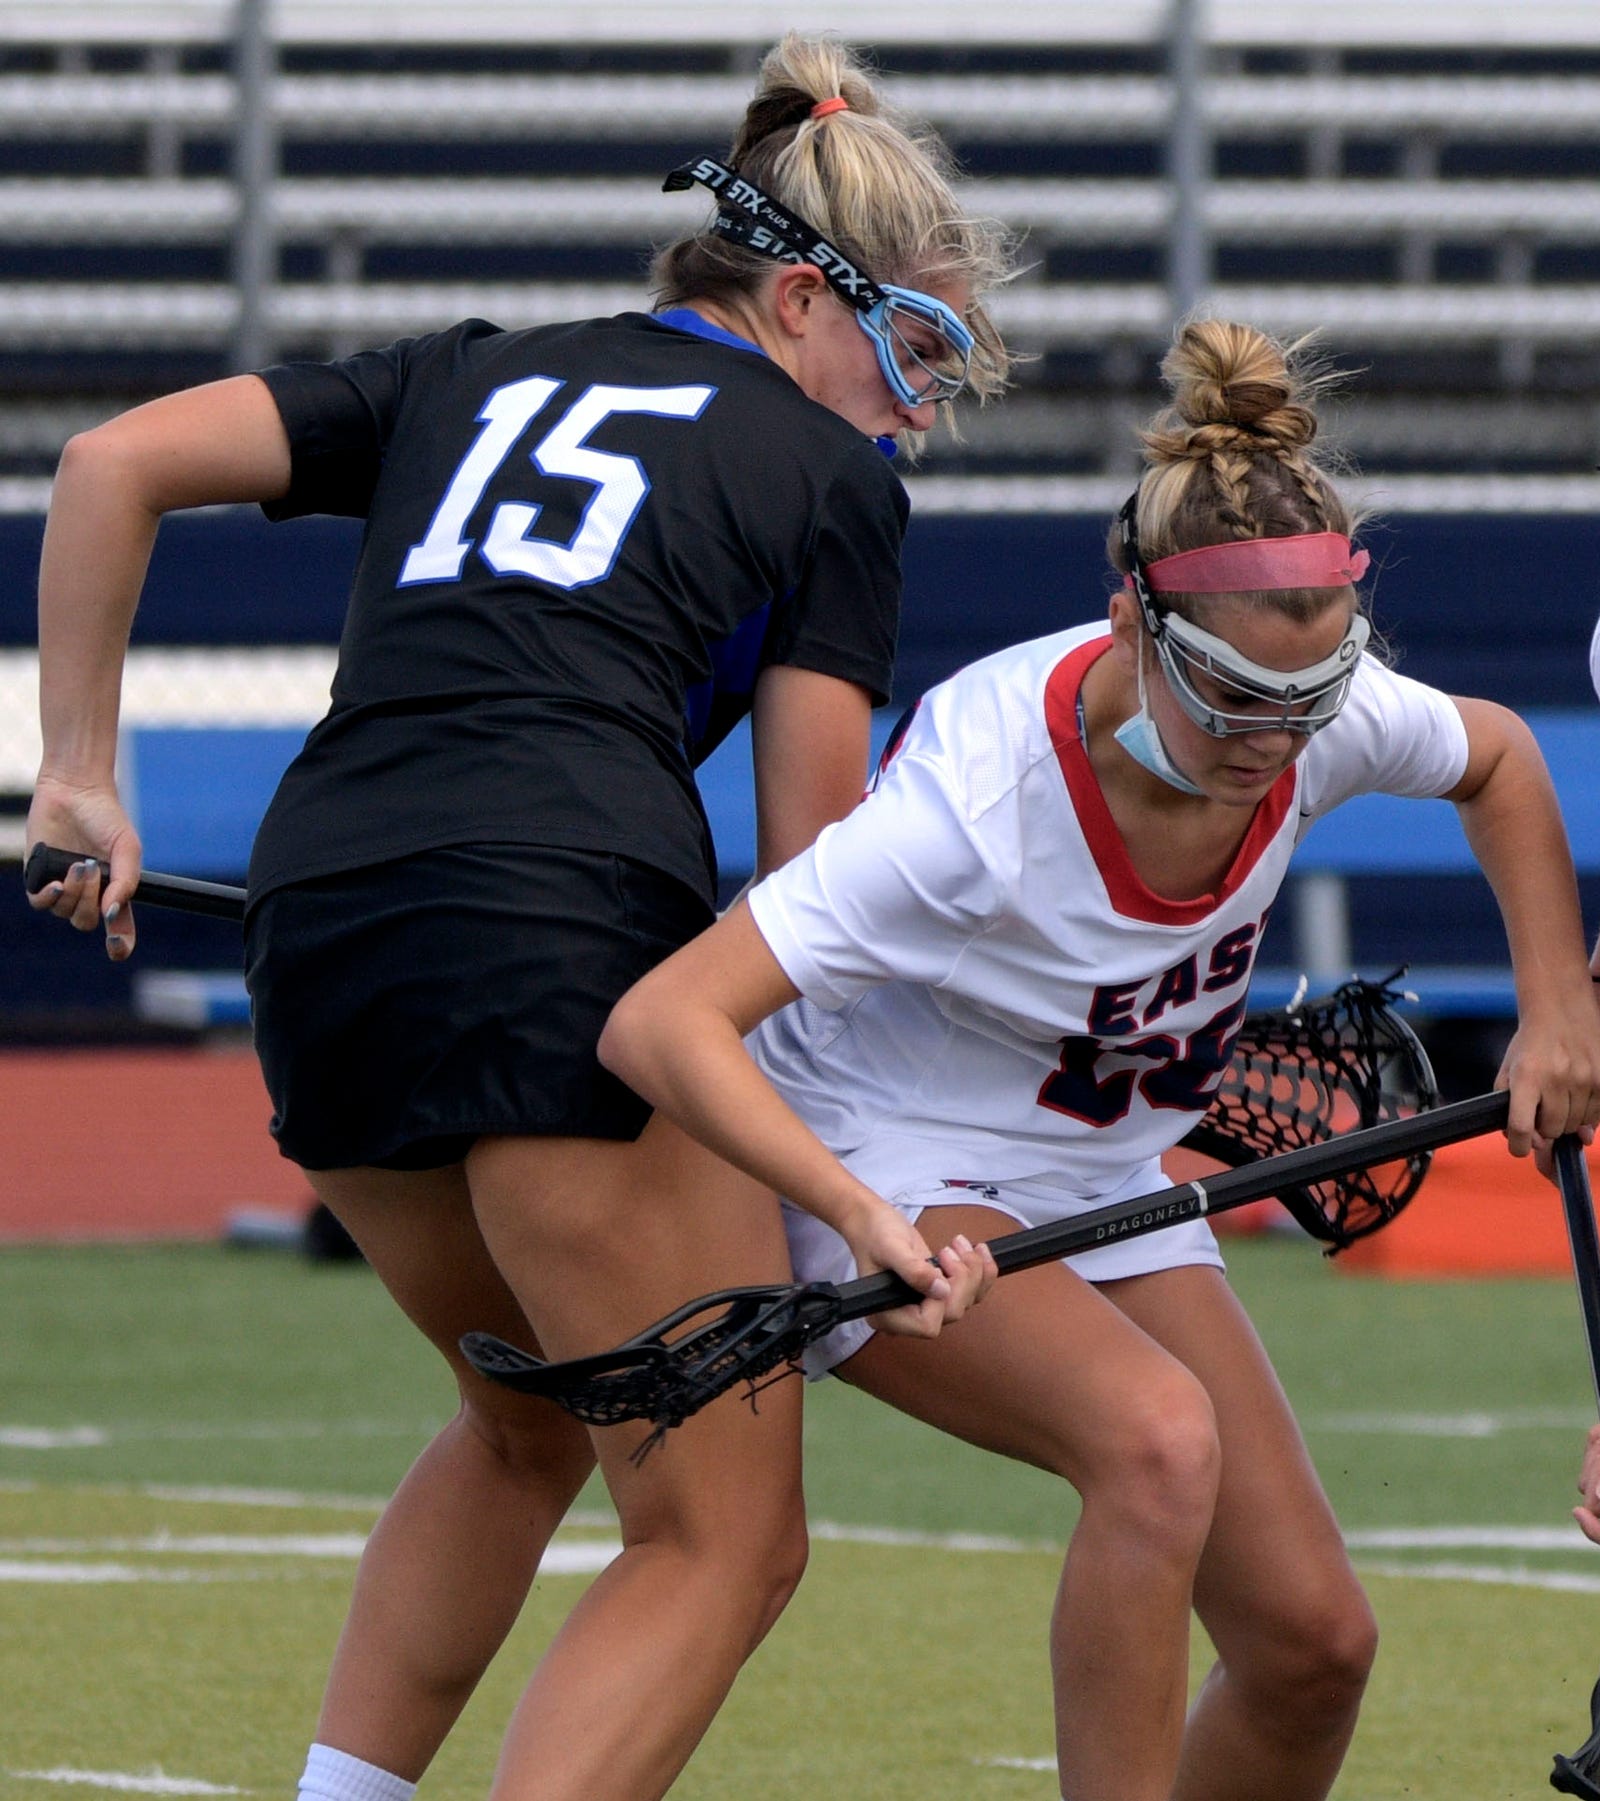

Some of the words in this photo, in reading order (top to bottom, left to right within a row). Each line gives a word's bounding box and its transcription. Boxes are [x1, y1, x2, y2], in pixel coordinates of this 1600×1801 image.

[691, 158, 733, 188] ST
[726, 179, 768, 215] STX
[760, 206, 790, 229] PLUS
[806, 241, 869, 296] STX
[396, 374, 719, 591] 15
[1087, 904, 1272, 1036] EAS
[1096, 1199, 1197, 1240] DRAGONFLY
